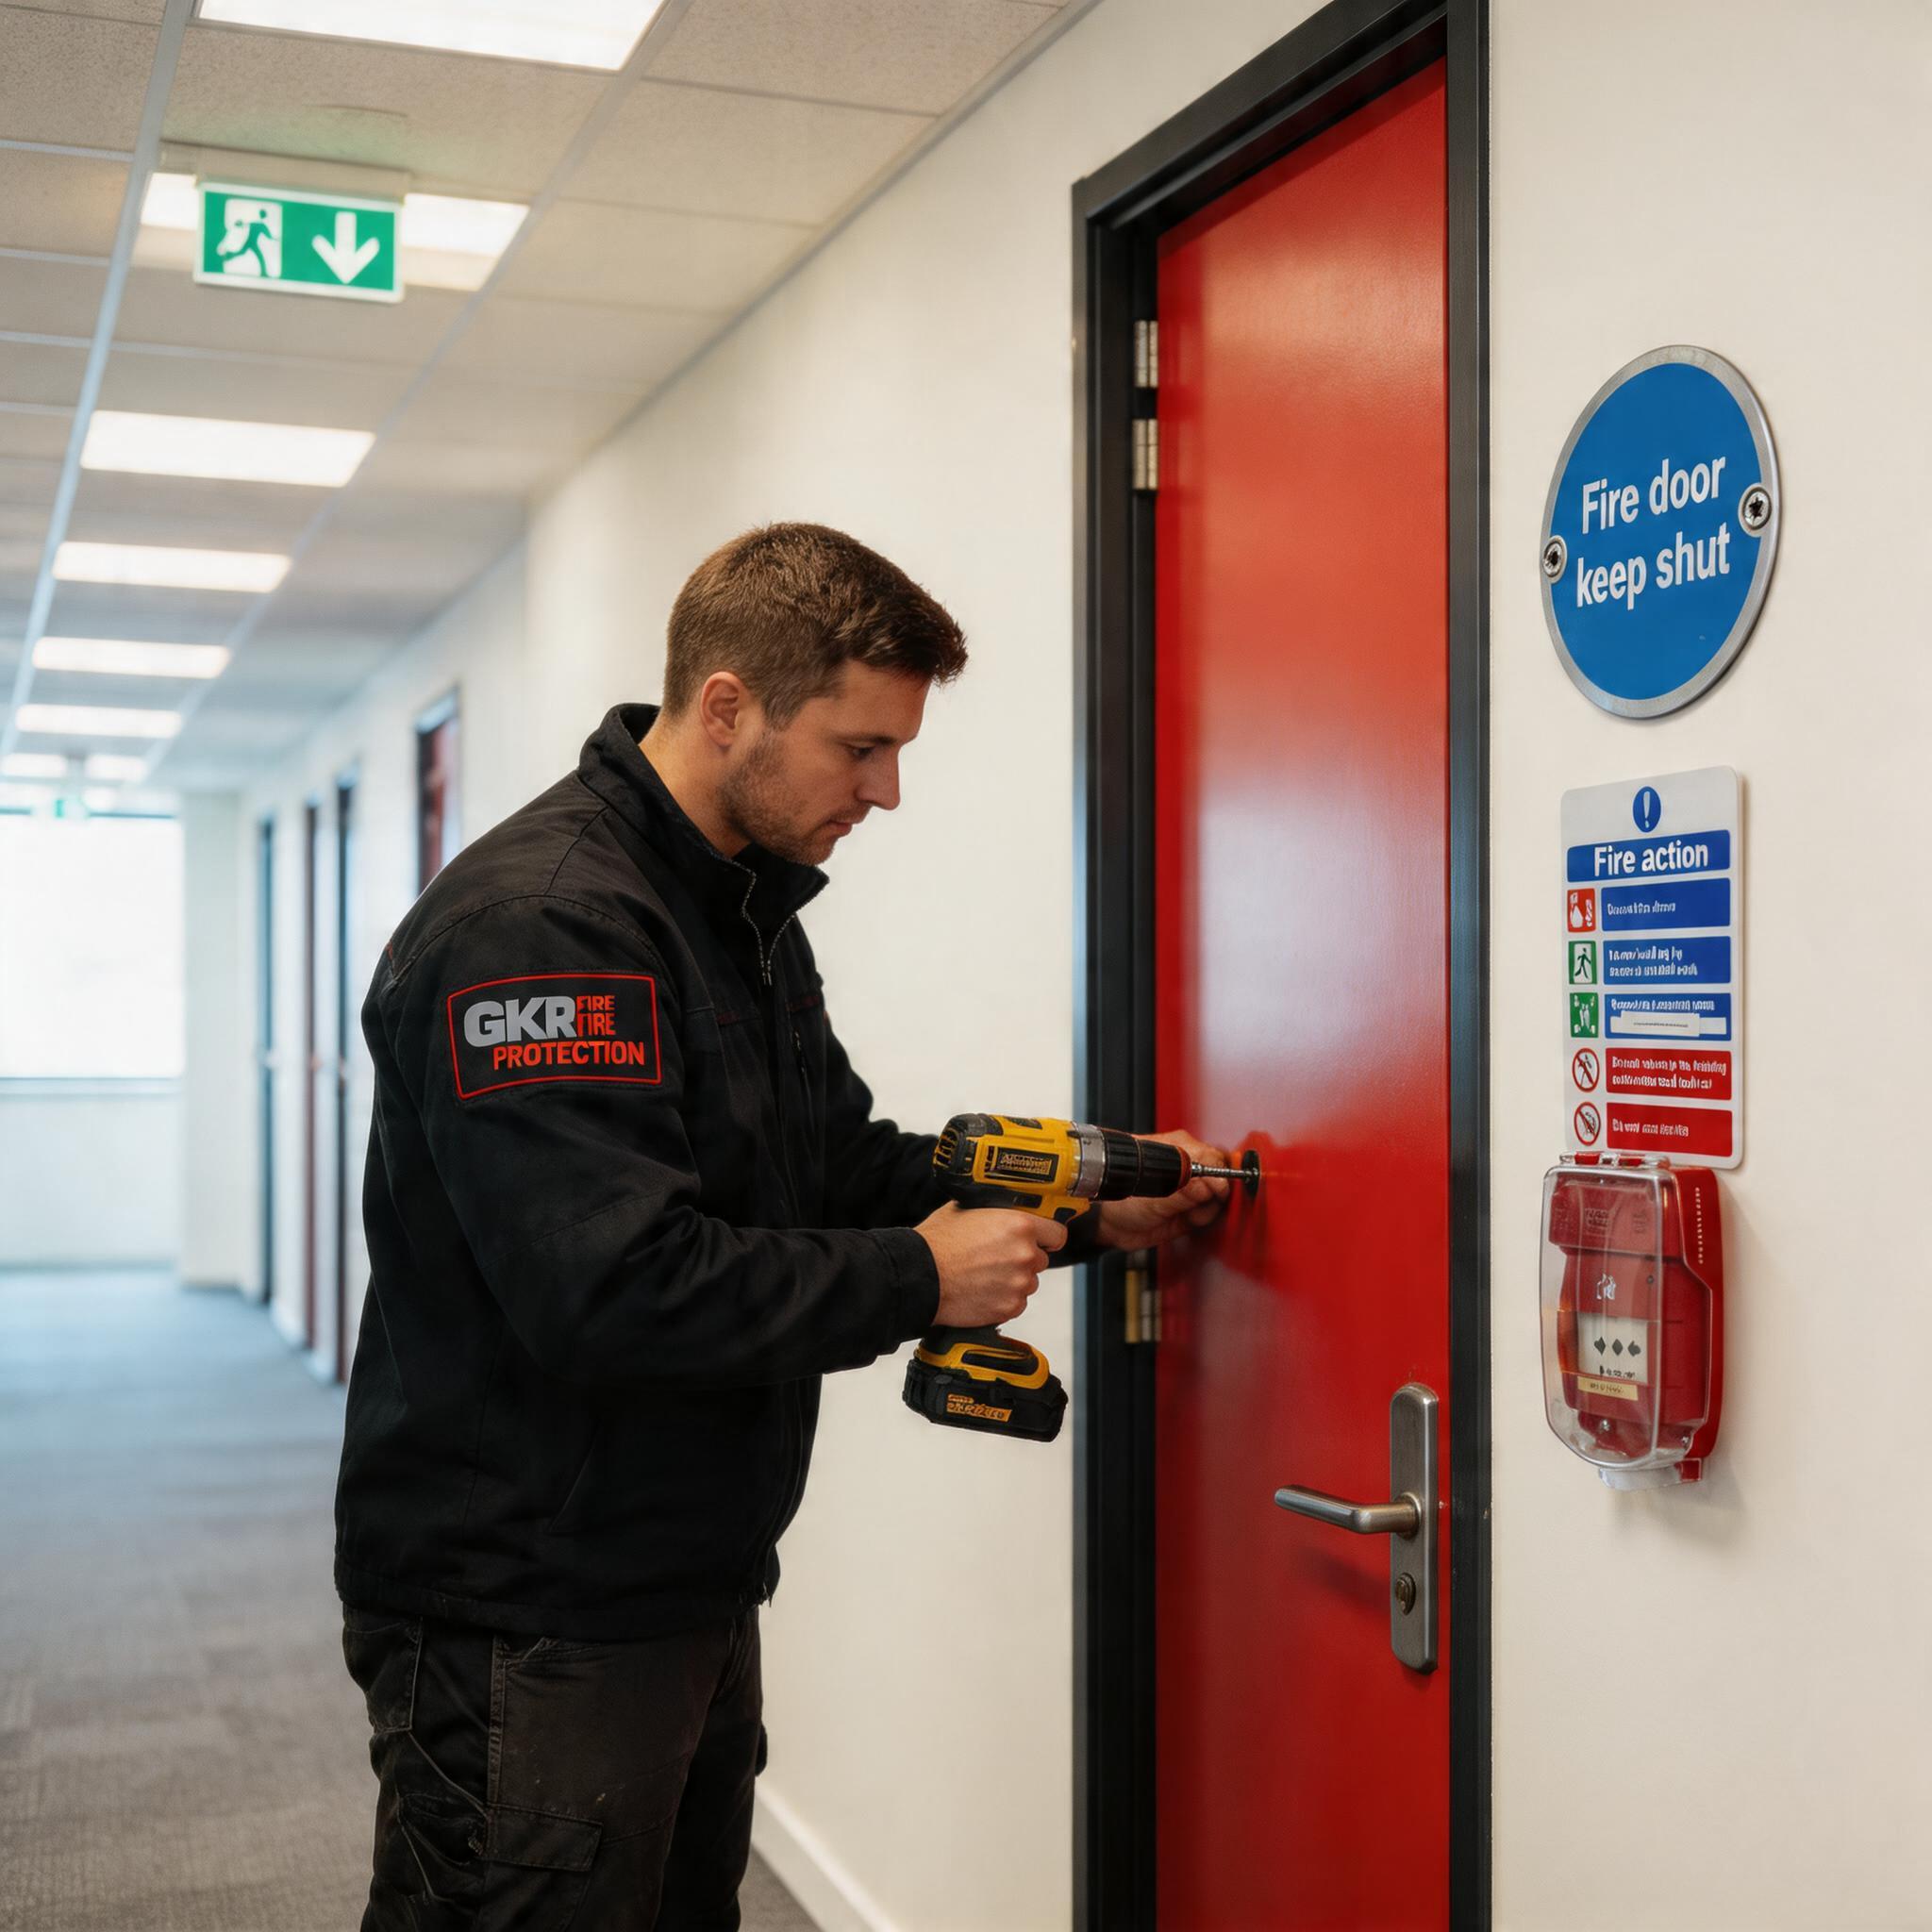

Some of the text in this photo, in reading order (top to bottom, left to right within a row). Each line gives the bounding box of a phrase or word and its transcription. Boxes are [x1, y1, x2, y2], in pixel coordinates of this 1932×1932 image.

[1582, 457, 1725, 534] Fire door
[1576, 523, 1730, 610] keep shut
[1594, 840, 1708, 876] Fire action
[464, 995, 615, 1047] GKR FIRE
[493, 1041, 645, 1071] PROTECTION
